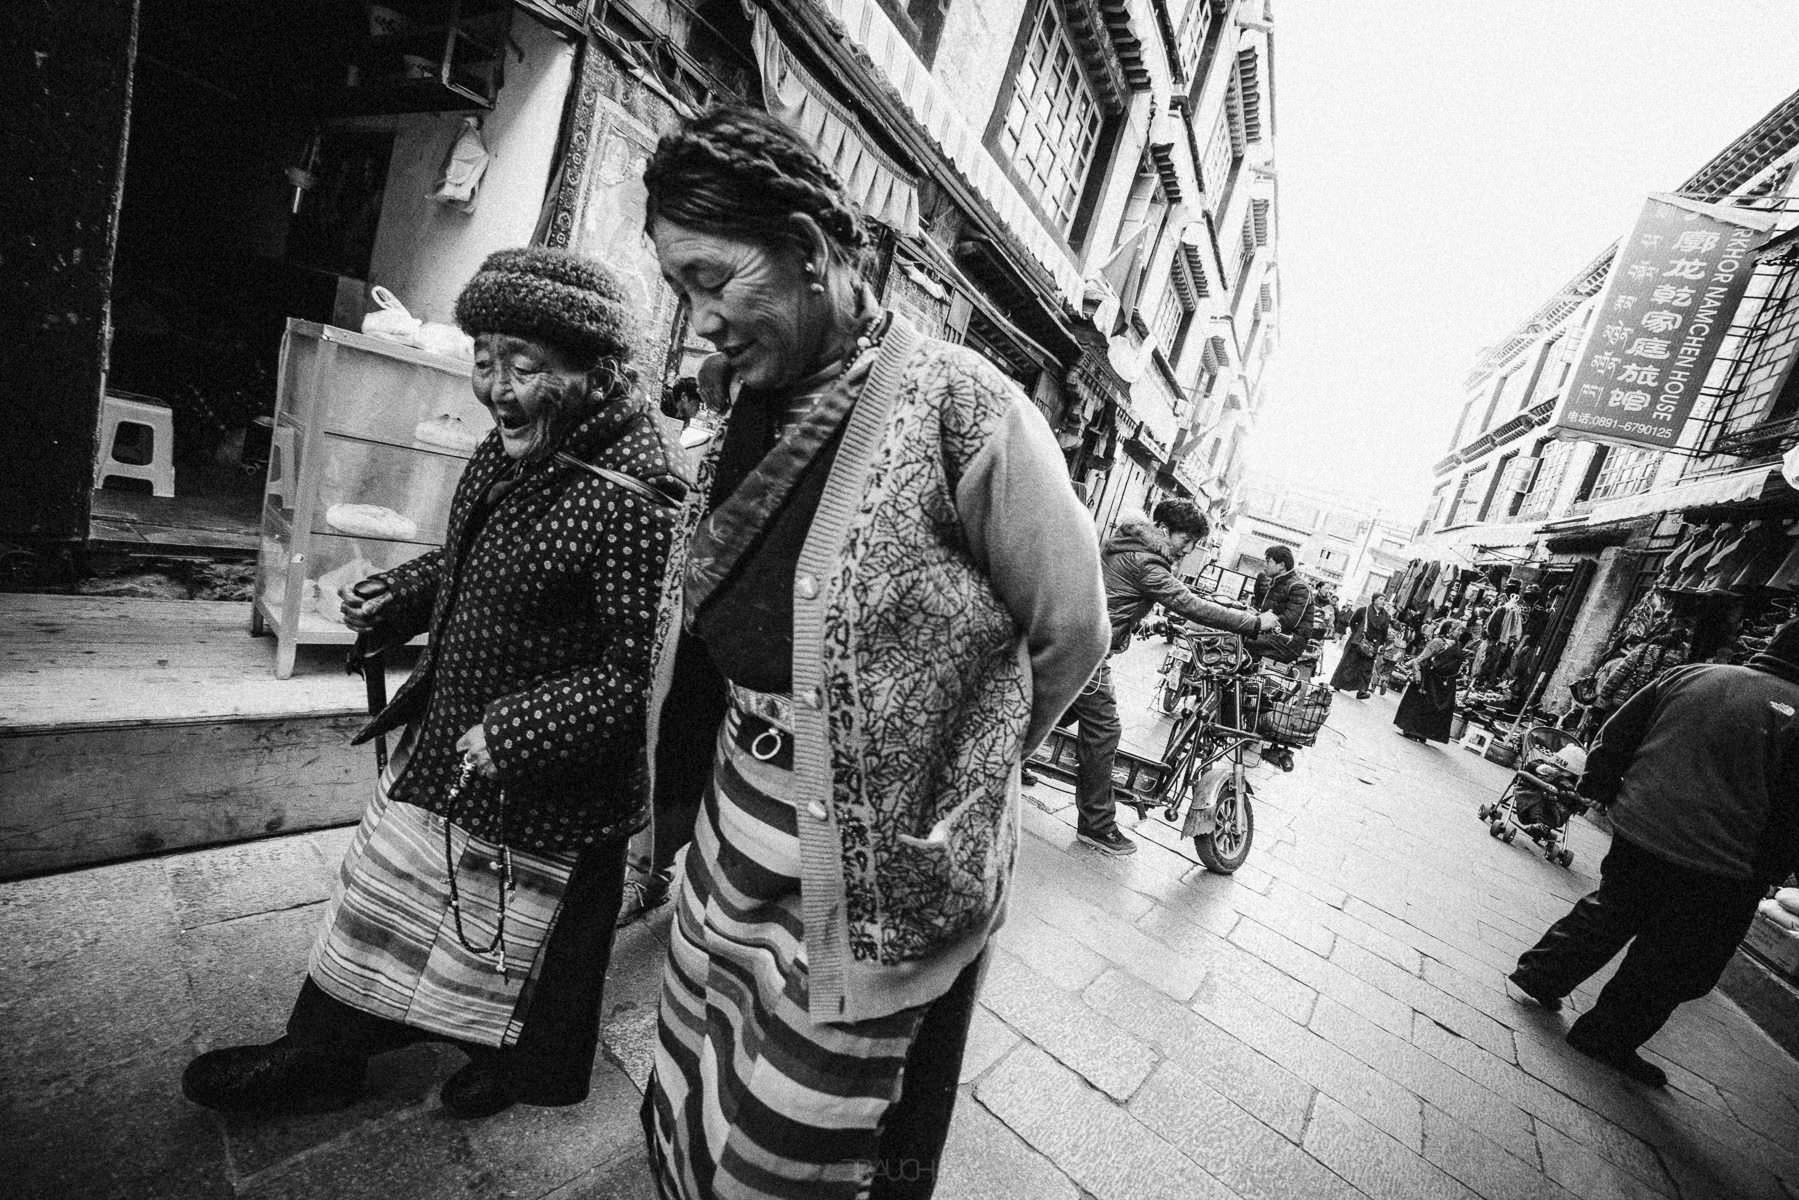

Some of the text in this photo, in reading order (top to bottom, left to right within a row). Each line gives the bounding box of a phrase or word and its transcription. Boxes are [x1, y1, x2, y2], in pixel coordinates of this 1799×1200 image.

[1652, 225, 1754, 421] RKHOR NAMCHEN HOUSE
